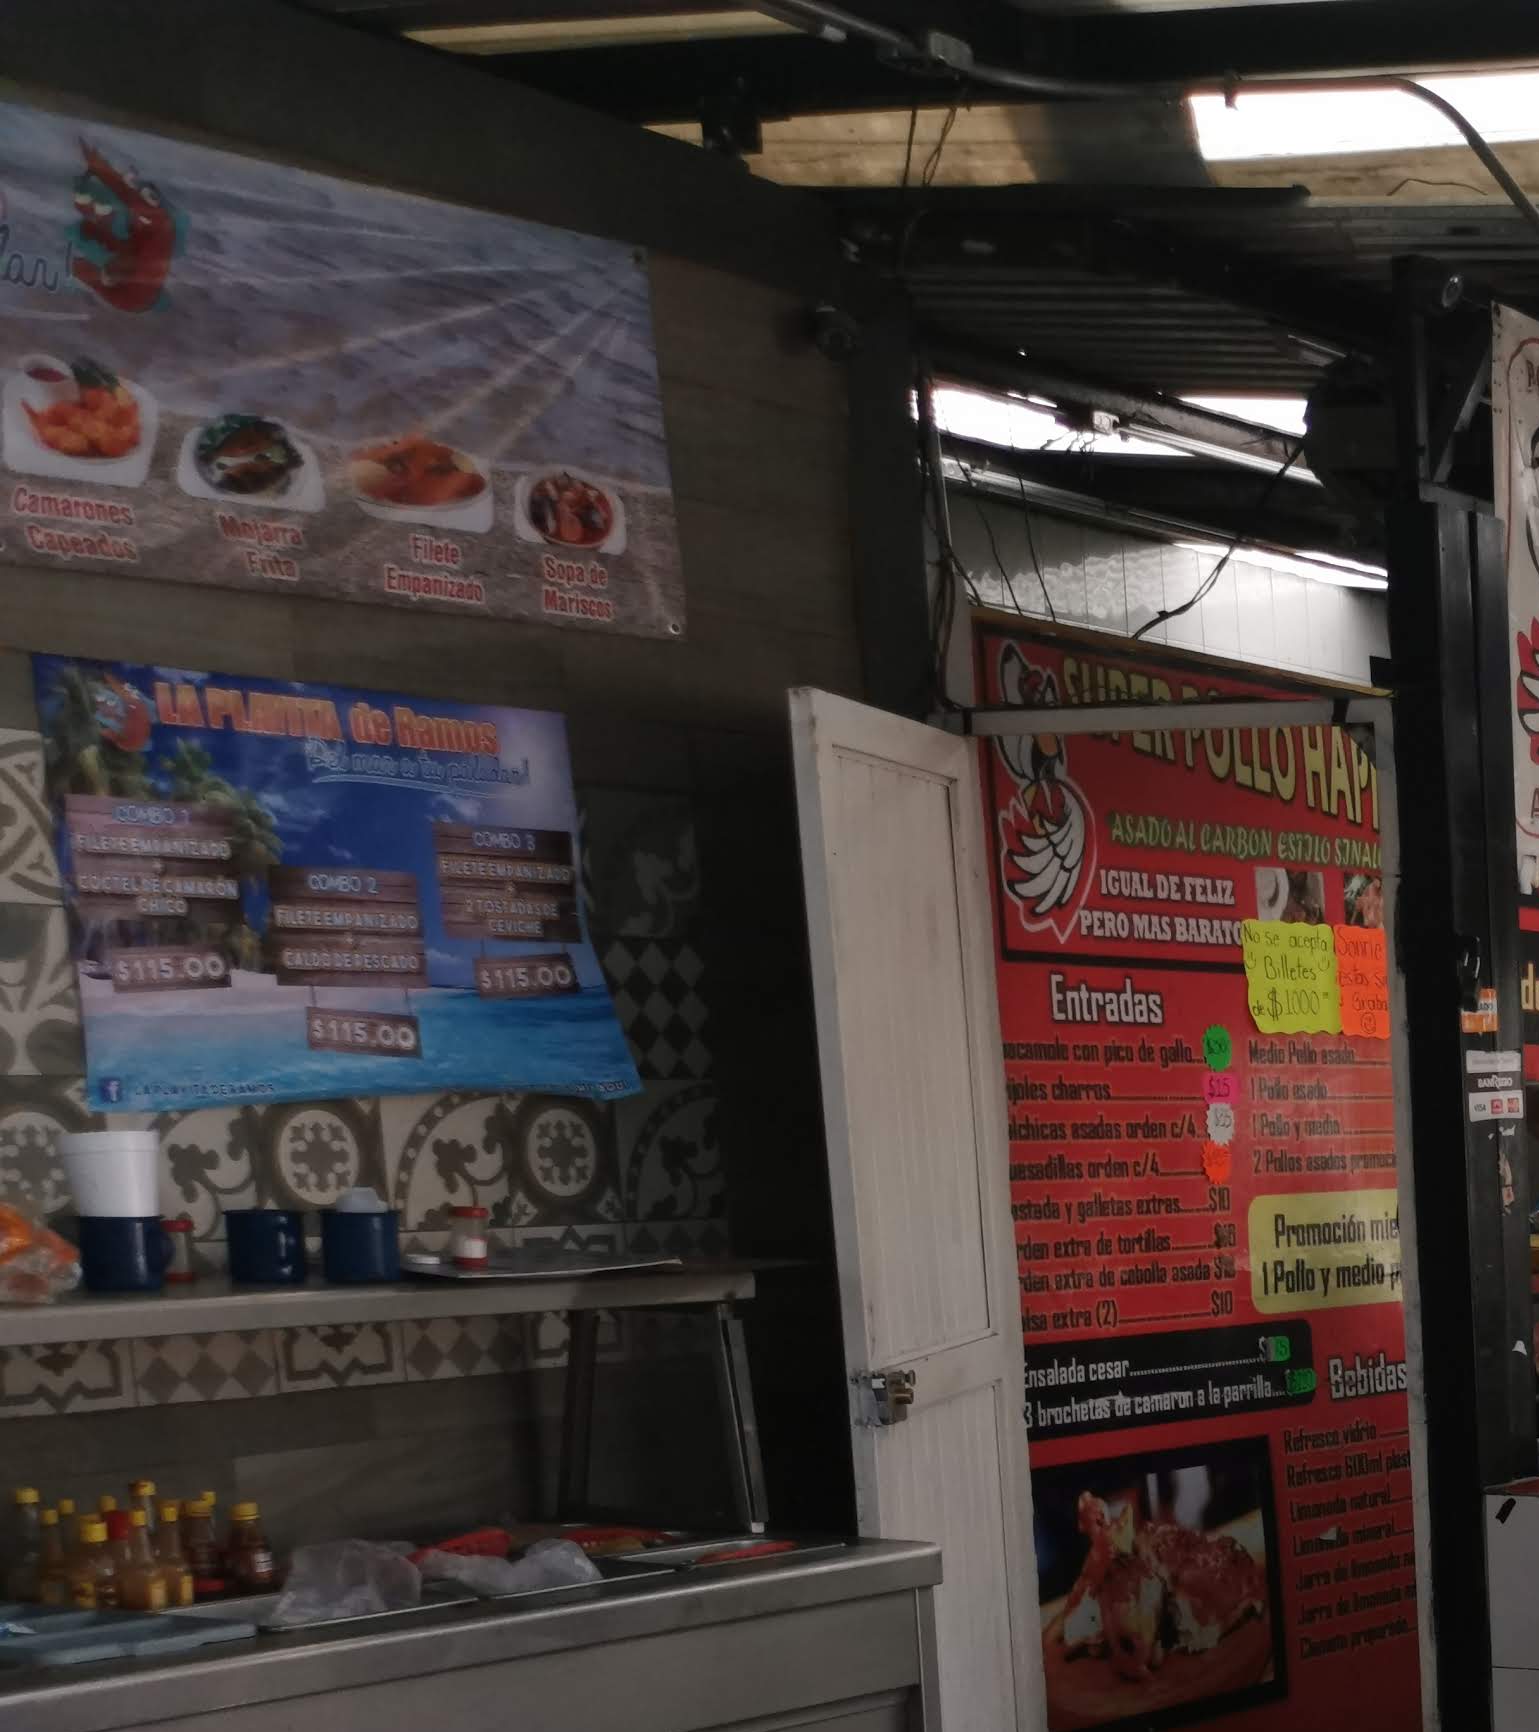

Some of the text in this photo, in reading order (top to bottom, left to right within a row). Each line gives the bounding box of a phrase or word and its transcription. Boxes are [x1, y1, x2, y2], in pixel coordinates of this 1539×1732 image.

[12, 486, 134, 526] Camarones
[26, 526, 138, 562] Capeados
[410, 534, 462, 566] Filete
[384, 565, 484, 602] Empanizado
[545, 556, 608, 586] Sopa de
[543, 589, 613, 621] Mariscos
[351, 701, 391, 745] de
[393, 705, 498, 755] Ramos
[473, 831, 521, 850] COMBO
[1111, 812, 1331, 866] ASADO AL CARBON ESTILO
[308, 874, 363, 893] COMBO
[1100, 867, 1236, 905] IGUAL DE FELIZ
[1079, 909, 1171, 942] PERO MAS
[1289, 931, 1328, 955] acepta
[480, 965, 572, 991] $115.00
[1263, 955, 1317, 982] Billetes
[1050, 972, 1164, 1026] Entradas
[1104, 1040, 1154, 1067] pico de
[1051, 1075, 1111, 1101] charros
[1071, 1115, 1167, 1141] asadas orden
[1078, 1195, 1180, 1224] galletas extras
[1054, 1230, 1171, 1259] extra tortillas
[1275, 1212, 1366, 1250] Promoción
[1273, 1253, 1385, 1295] Pollo medio
[1211, 1289, 1235, 1318] $10
[1088, 1359, 1130, 1383] cesar
[1328, 1352, 1407, 1402] Bebidas
[1038, 1377, 1272, 1428] brochetas camaron parrilla
